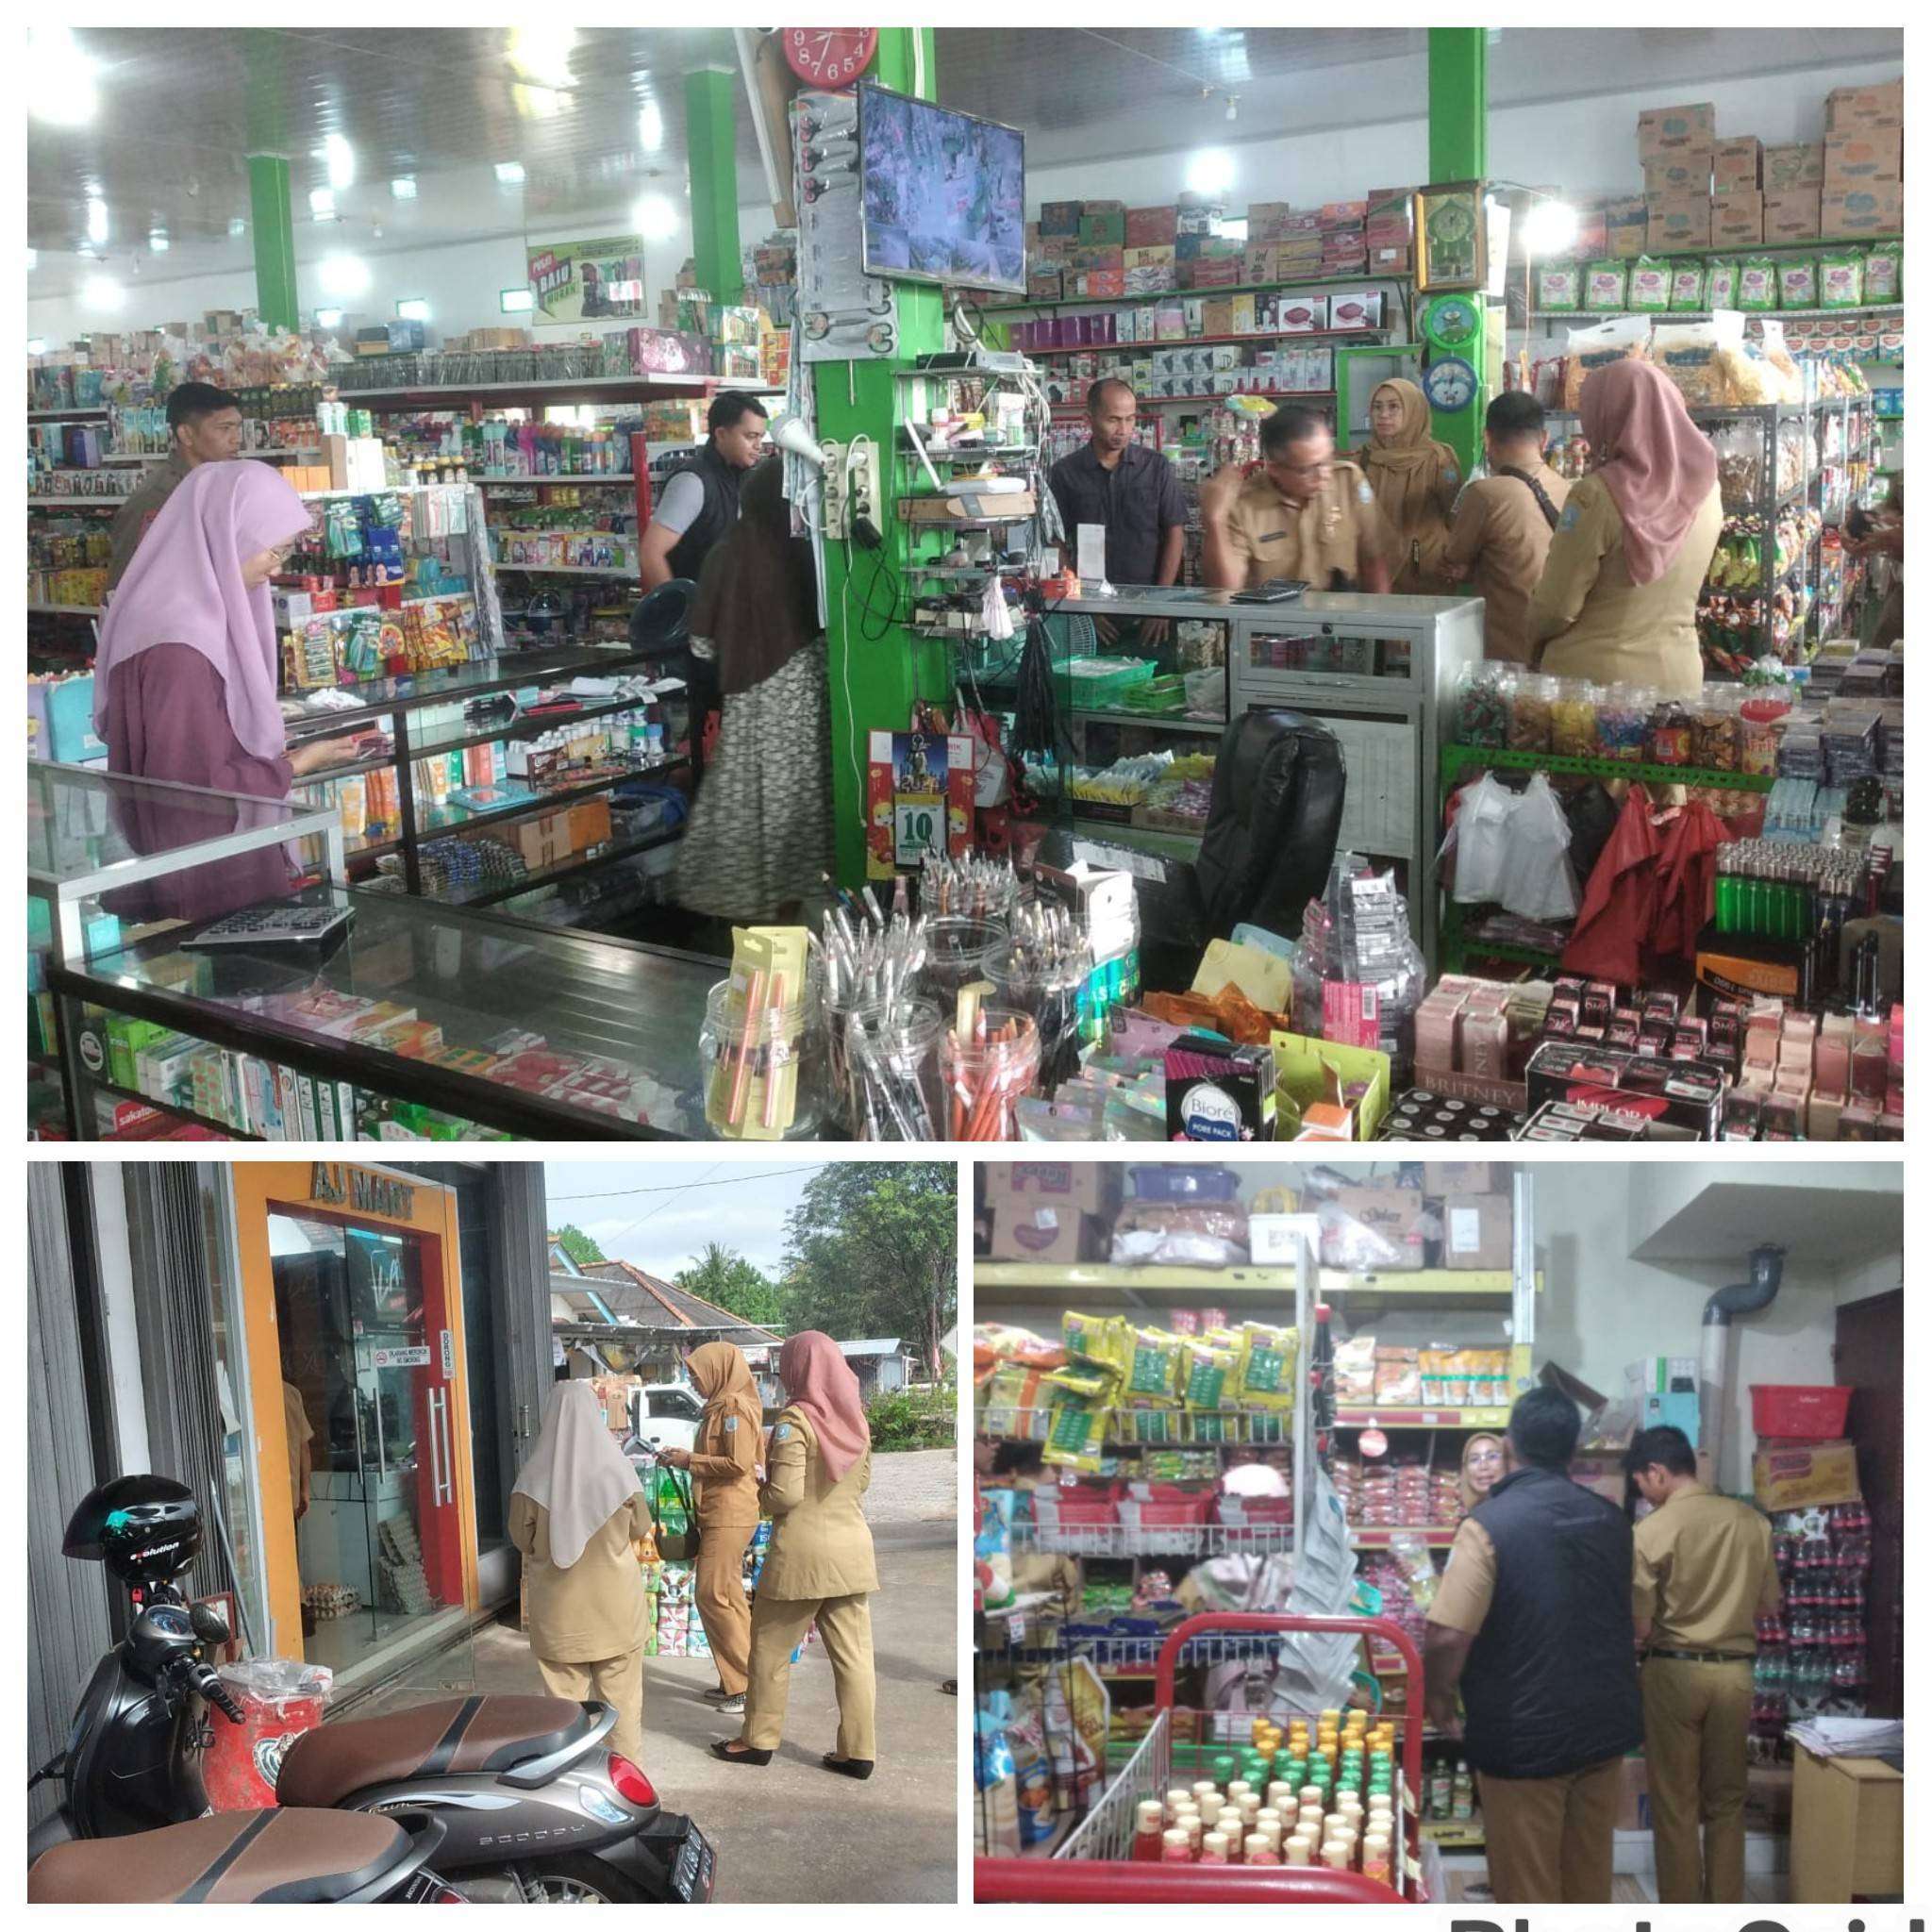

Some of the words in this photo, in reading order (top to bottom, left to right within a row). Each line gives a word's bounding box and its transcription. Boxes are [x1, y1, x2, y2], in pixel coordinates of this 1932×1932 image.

[793, 29, 805, 46] 9
[798, 47, 810, 64] 8
[853, 42, 863, 58] 4
[811, 60, 821, 76] 7
[827, 63, 839, 79] 6
[843, 58, 854, 73] 5
[541, 263, 570, 293] BAJU
[904, 812, 933, 841] 10
[1425, 1075, 1517, 1105] BRITNEY
